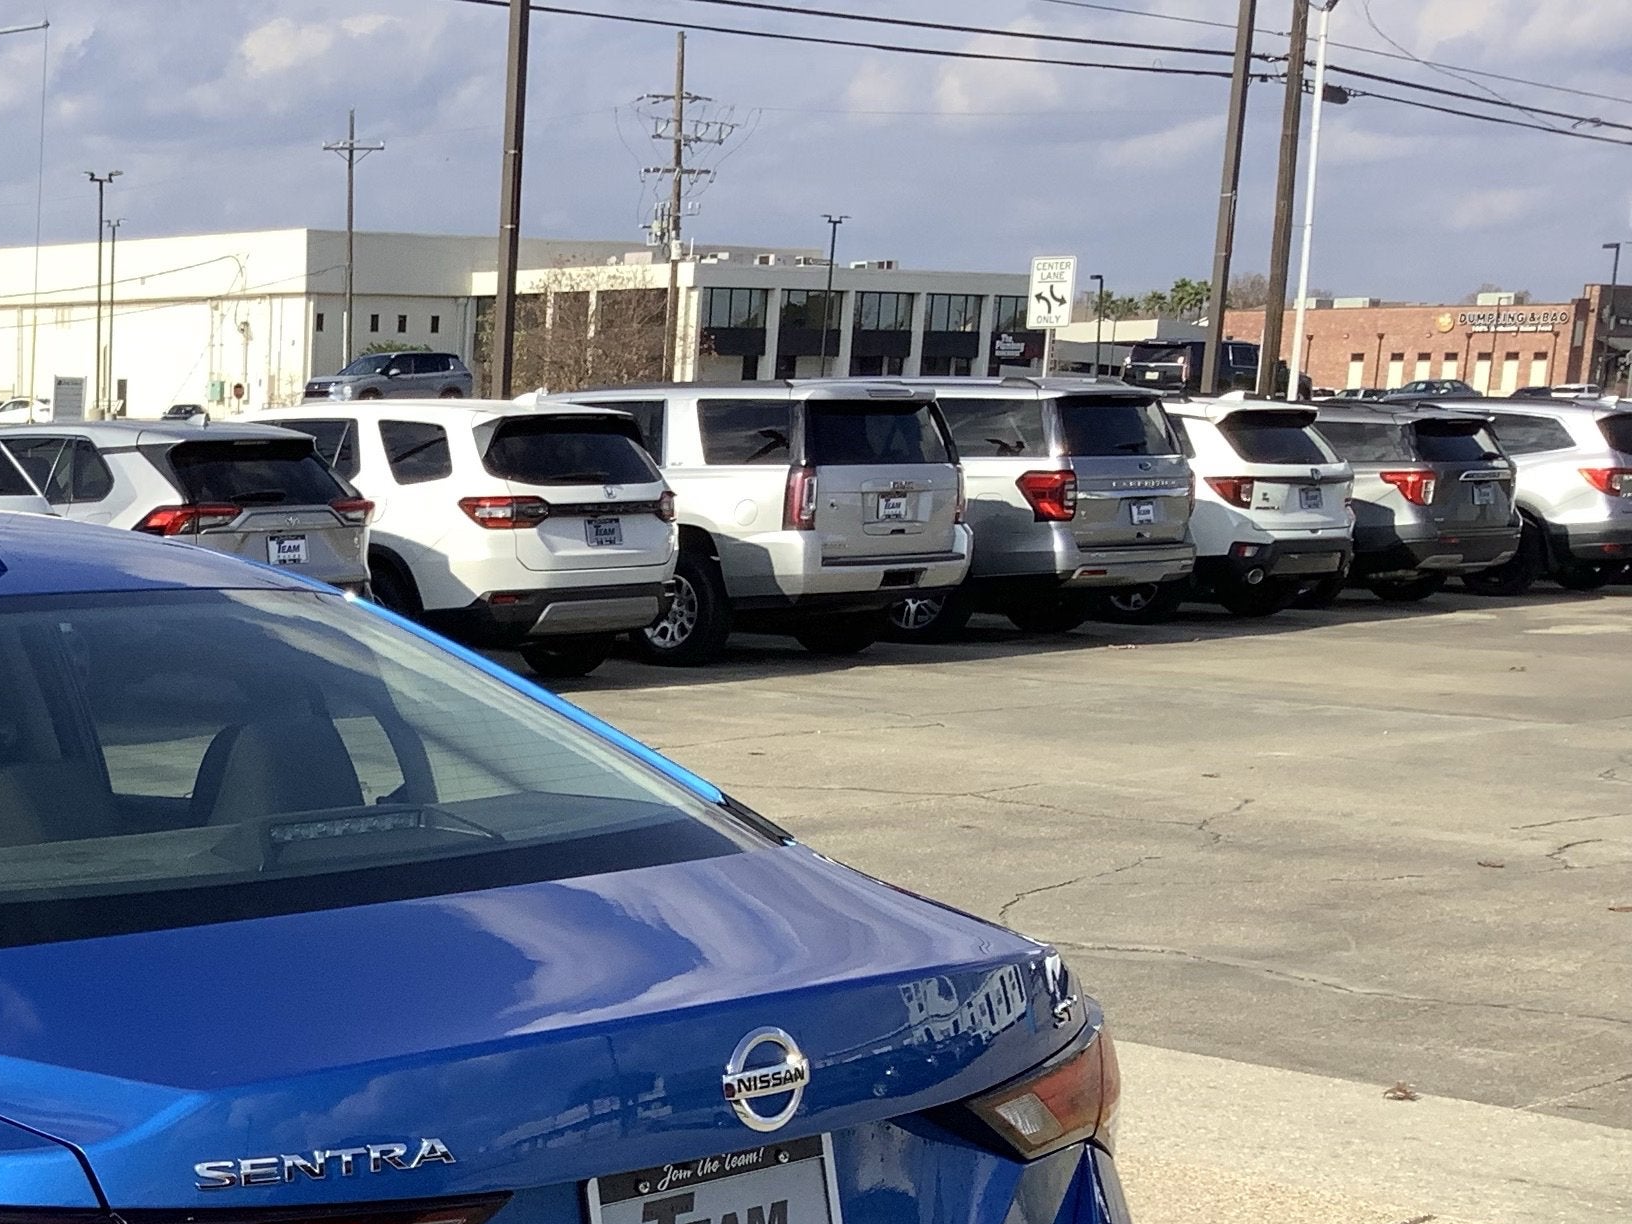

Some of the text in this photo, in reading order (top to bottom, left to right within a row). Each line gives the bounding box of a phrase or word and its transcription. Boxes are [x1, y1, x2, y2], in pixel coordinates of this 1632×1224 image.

[1036, 261, 1072, 271] CENTER
[1041, 272, 1065, 280] LANE
[1036, 315, 1061, 324] ONLY
[1529, 312, 1538, 323] &
[1541, 311, 1569, 324] BAO
[276, 540, 301, 554] TEAM
[737, 1064, 805, 1093] NISSAN
[194, 1137, 457, 1191] SENTRA
[696, 1156, 720, 1176] the
